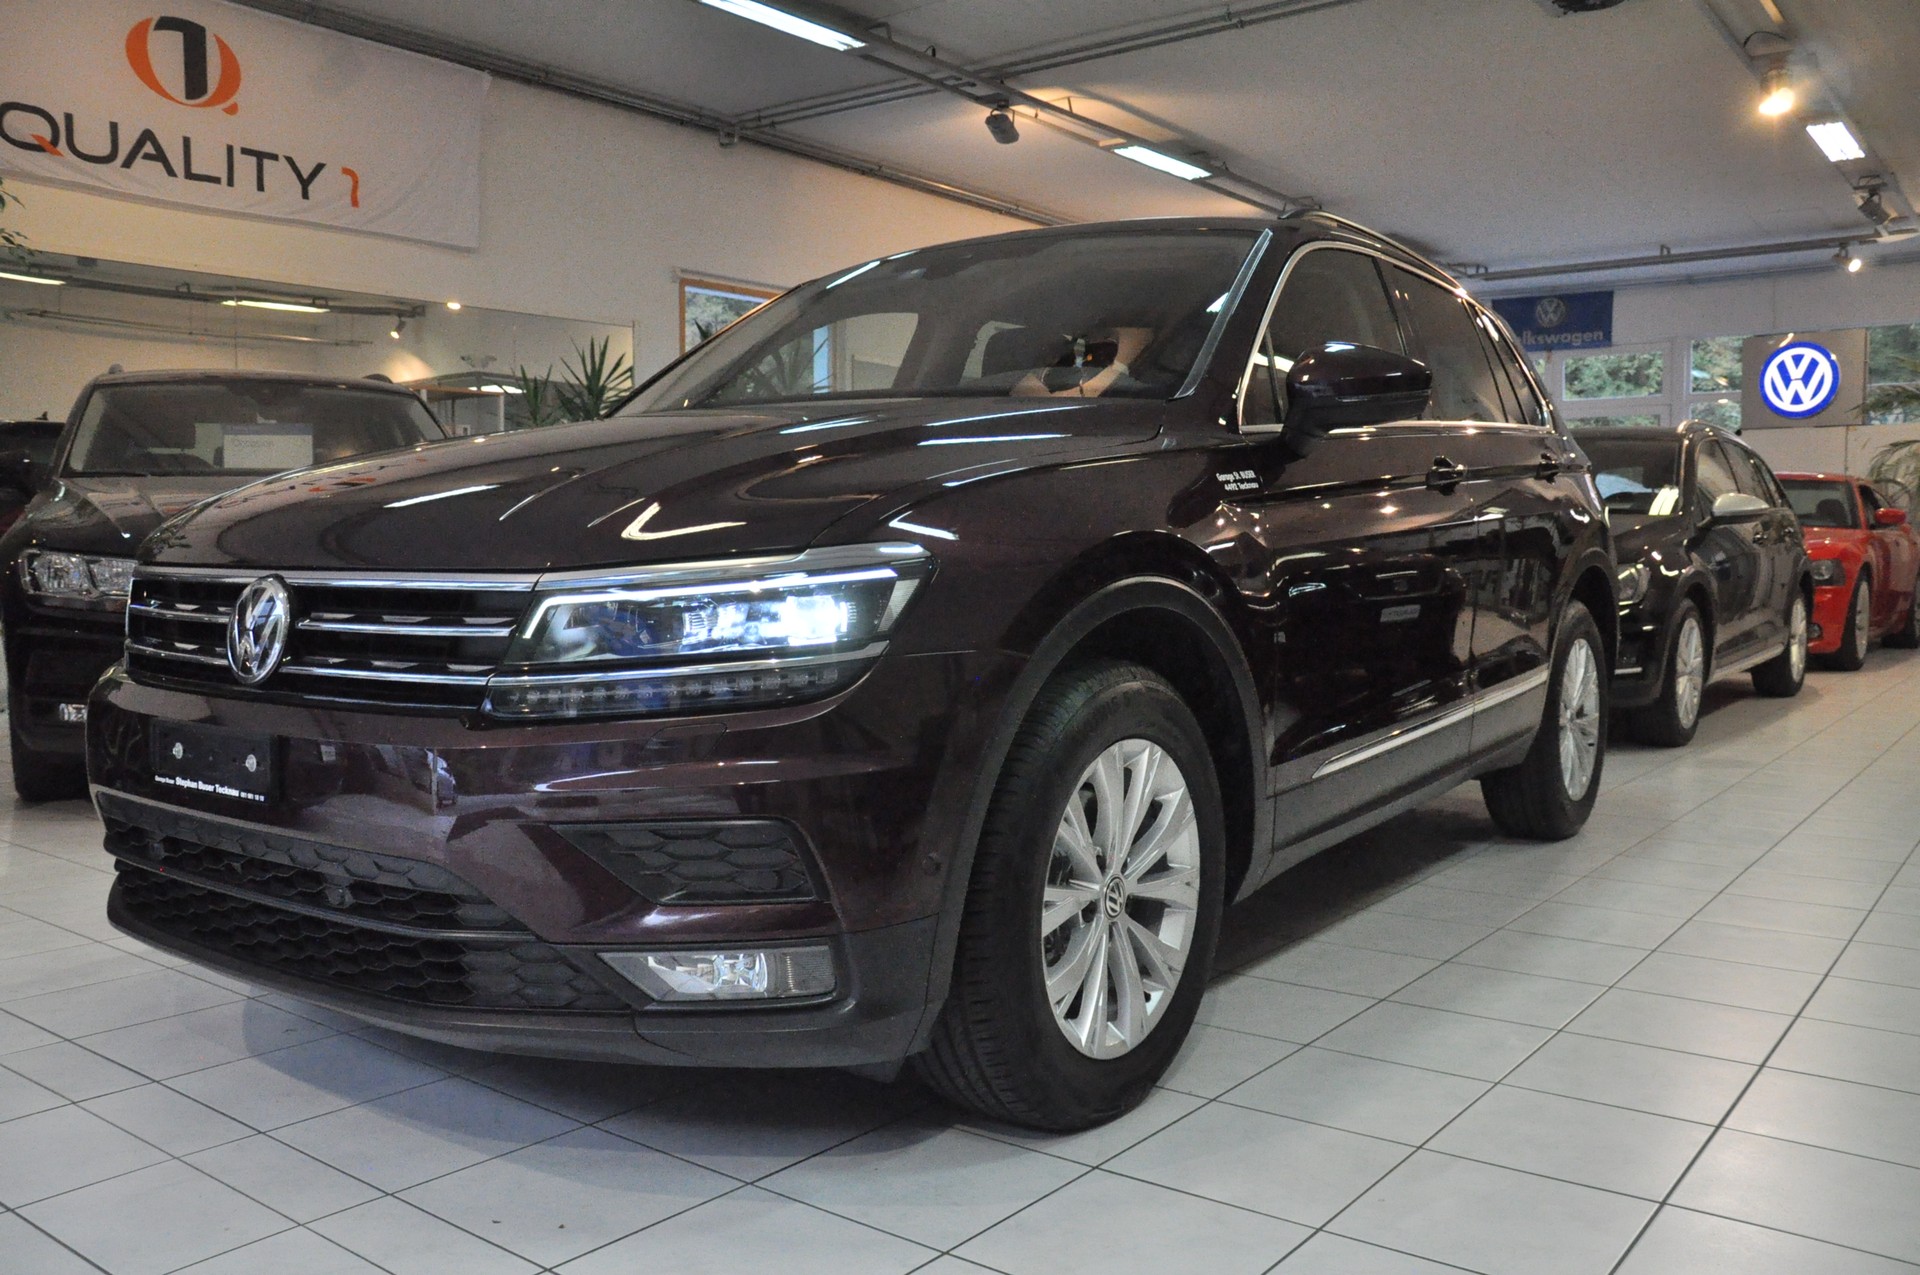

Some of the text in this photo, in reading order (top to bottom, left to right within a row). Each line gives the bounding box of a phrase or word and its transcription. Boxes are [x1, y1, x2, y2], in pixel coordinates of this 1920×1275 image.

[0, 101, 327, 201] QUALITY
[1515, 331, 1604, 346] lkswagen
[1761, 343, 1837, 417] VW
[175, 776, 199, 789] Stephan
